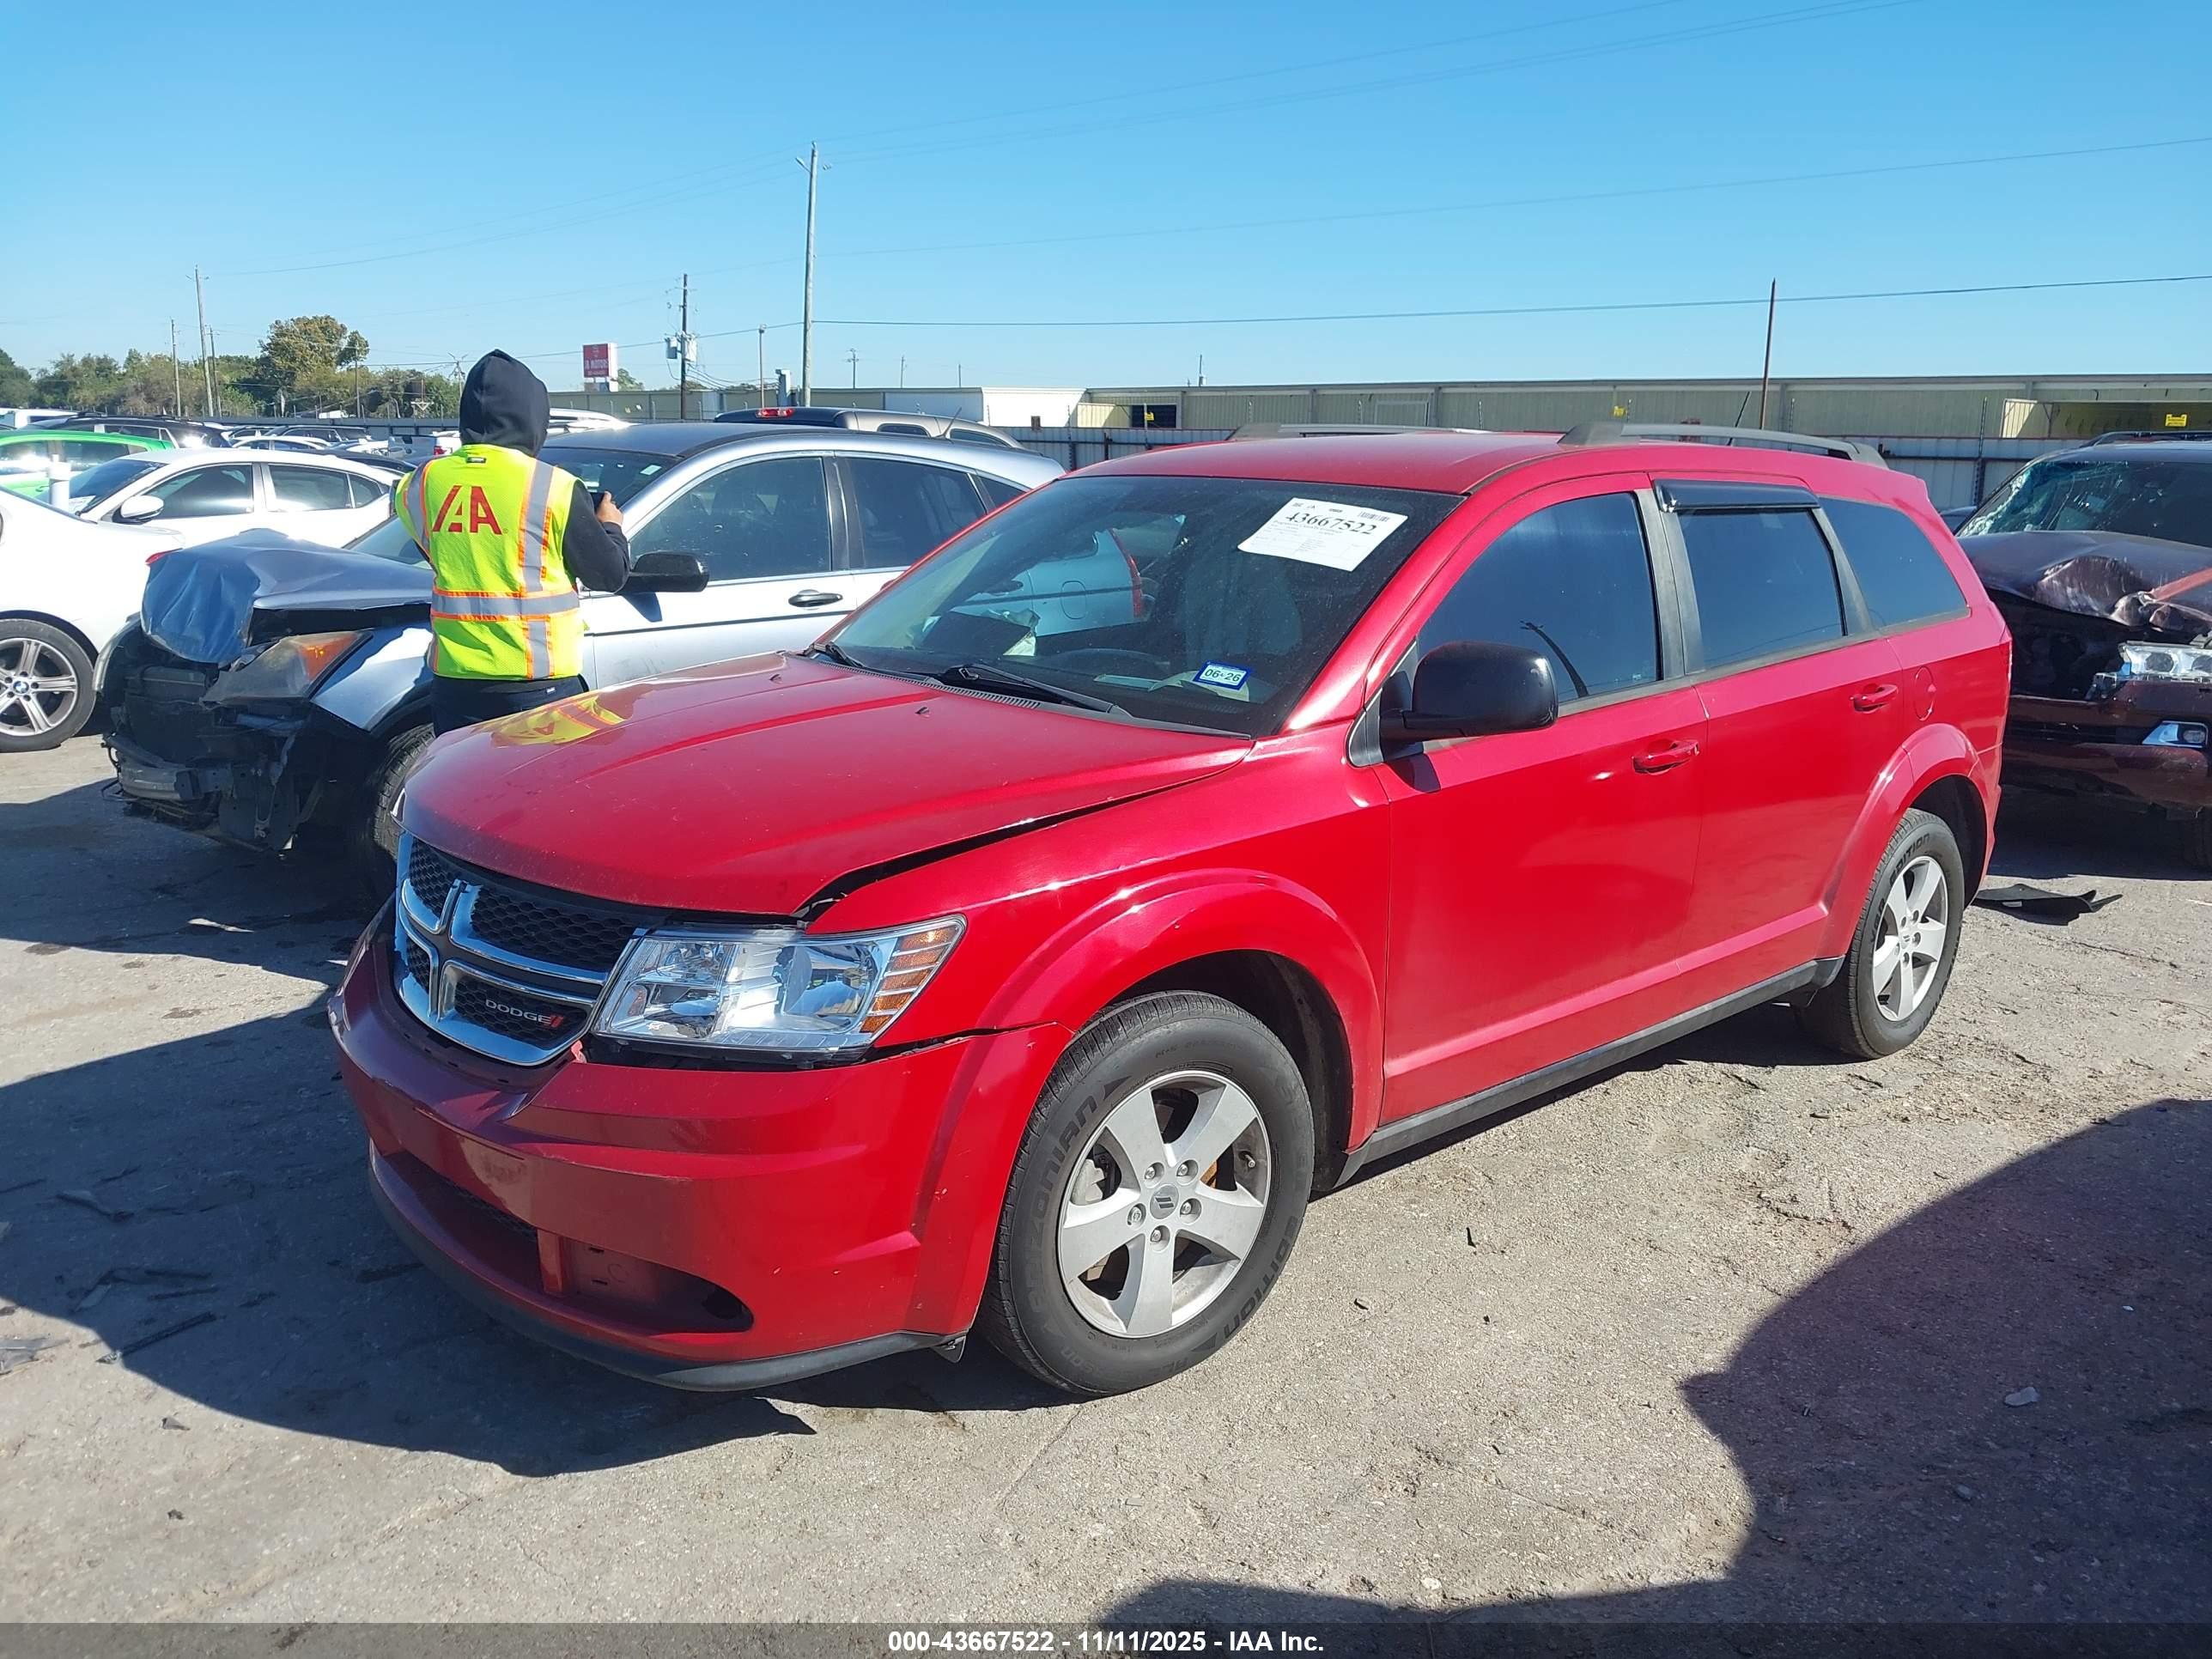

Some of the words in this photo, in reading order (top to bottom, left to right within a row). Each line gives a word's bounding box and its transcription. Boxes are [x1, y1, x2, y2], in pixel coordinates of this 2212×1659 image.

[1285, 511, 1377, 536] 43667522
[1204, 668, 1221, 678] 06
[1224, 672, 1243, 682] 26
[485, 999, 552, 1025] DODGE
